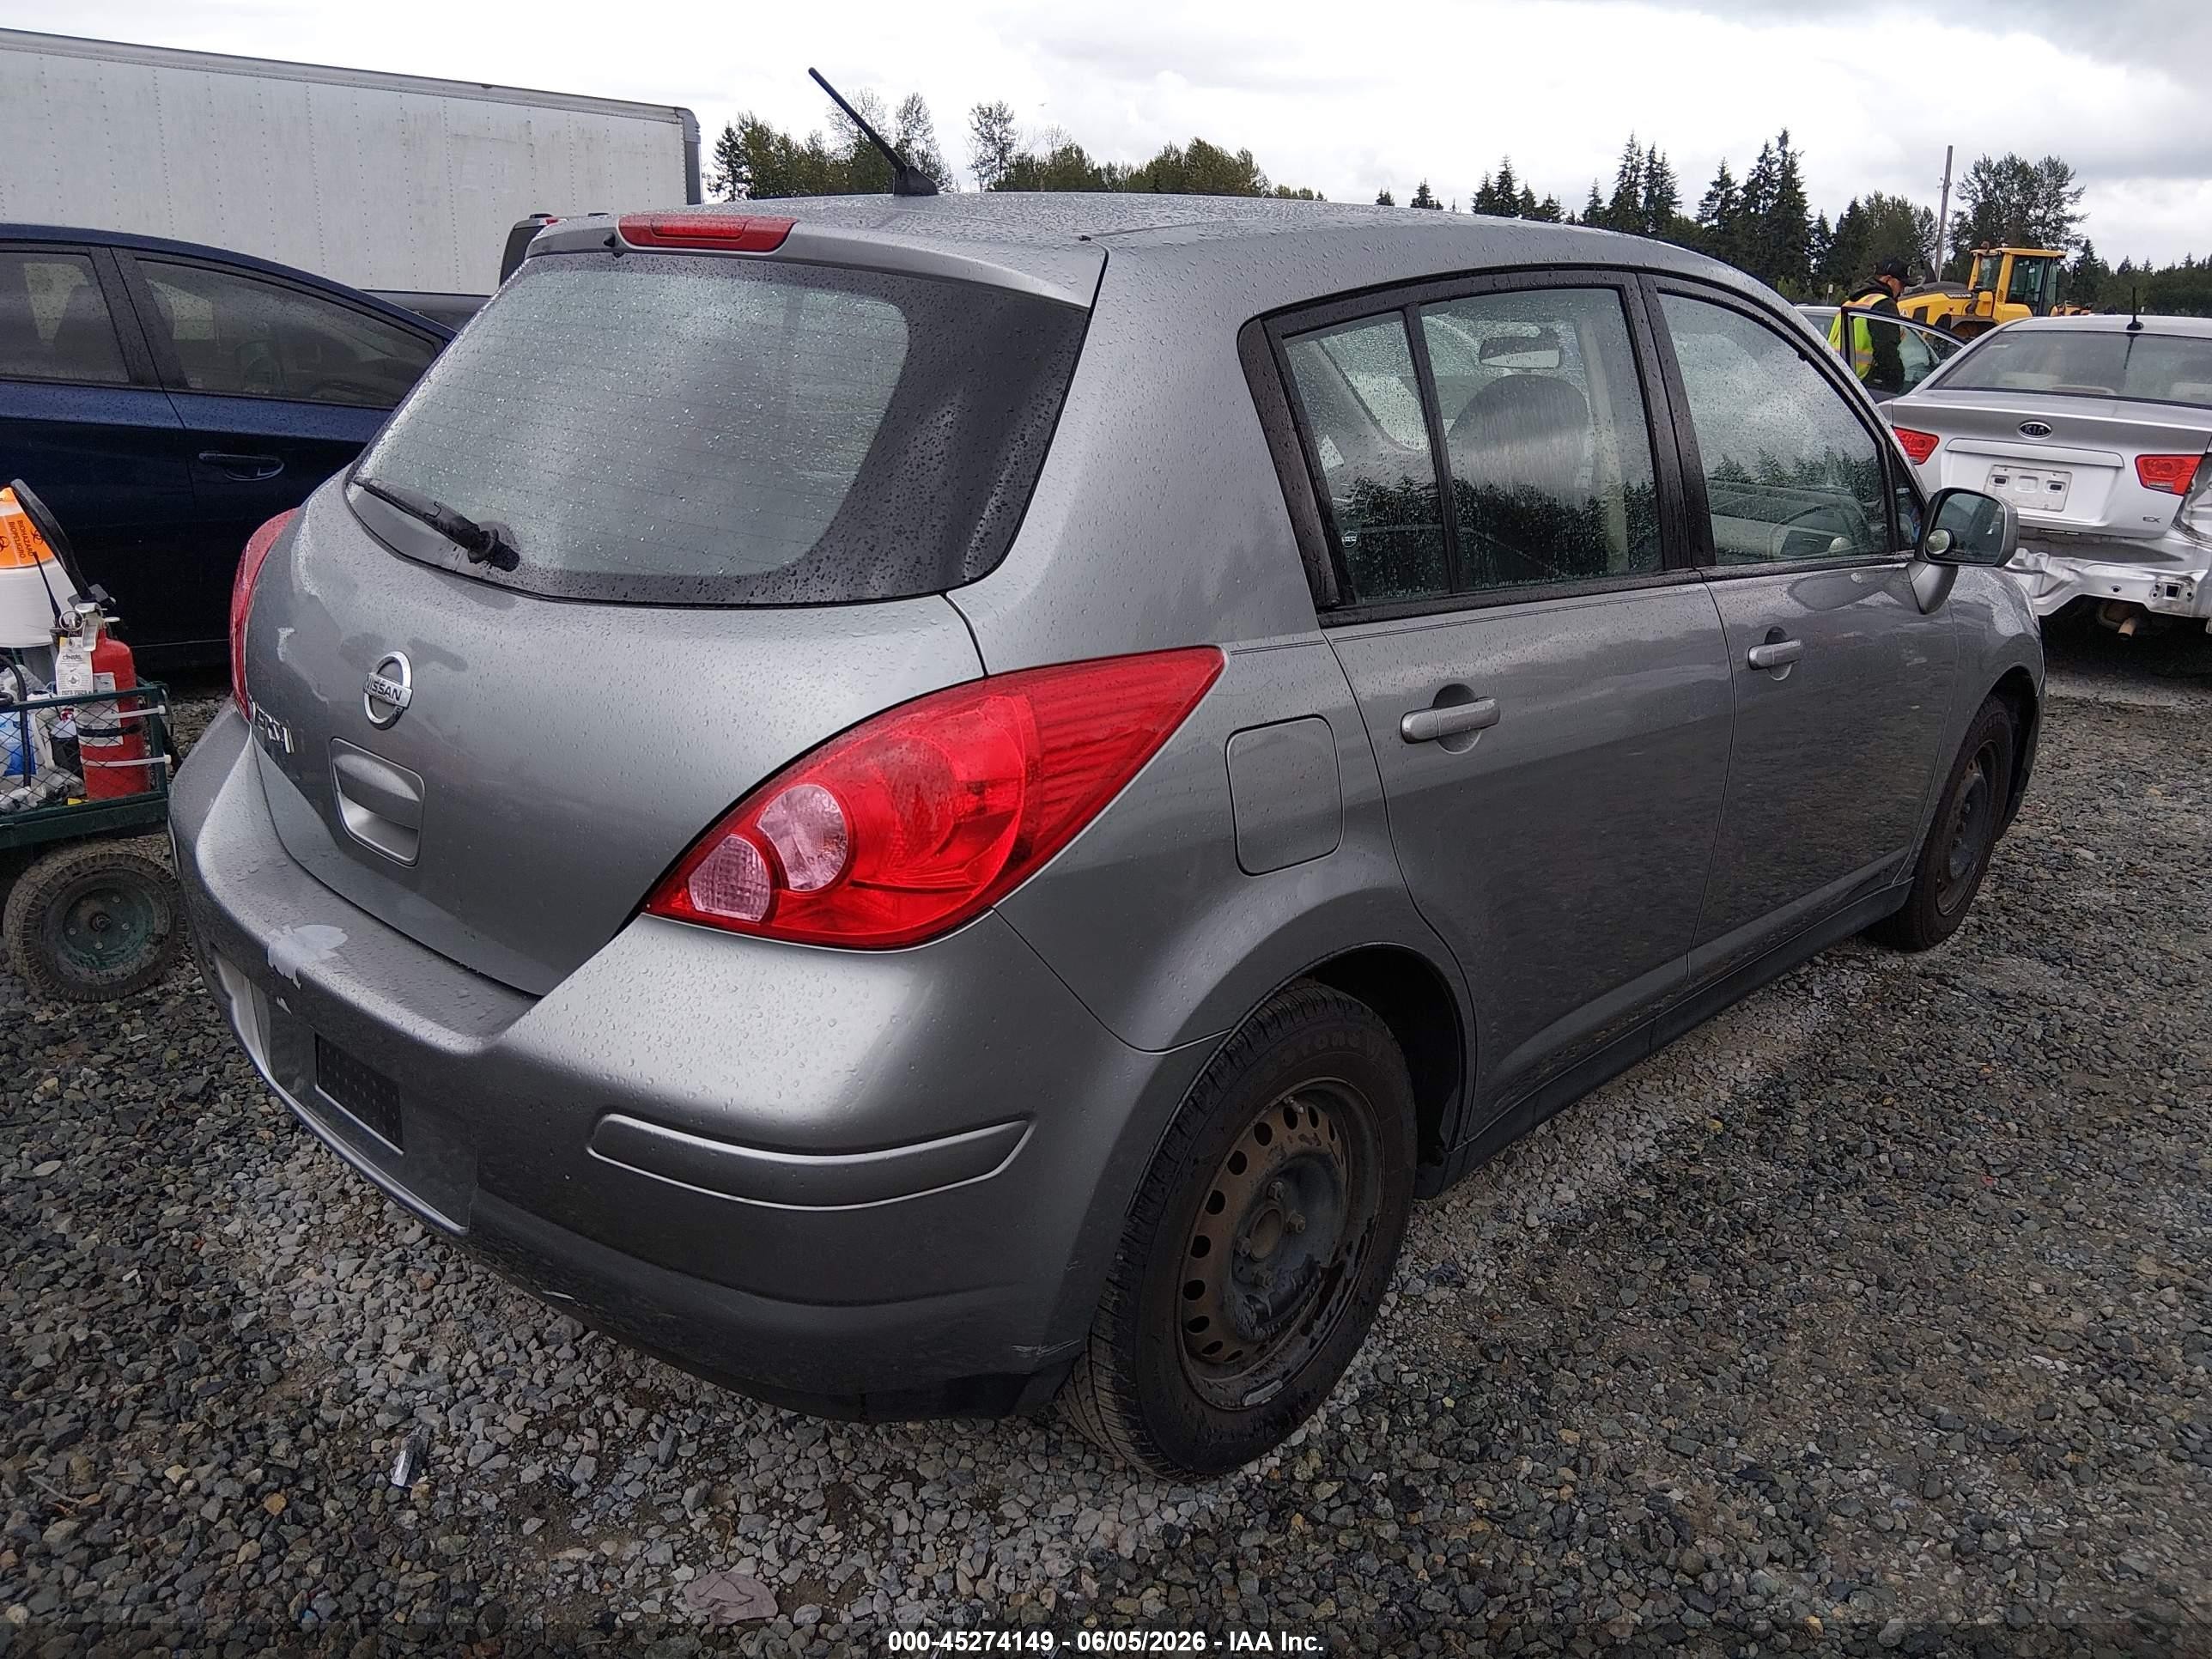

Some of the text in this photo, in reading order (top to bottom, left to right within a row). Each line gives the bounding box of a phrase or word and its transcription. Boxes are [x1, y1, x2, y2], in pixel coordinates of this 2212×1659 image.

[2024, 424, 2045, 434] KIA
[9, 521, 27, 559] BIOPELIGRO
[17, 519, 34, 557] BIOHAZARD
[367, 674, 403, 702] NISSAN
